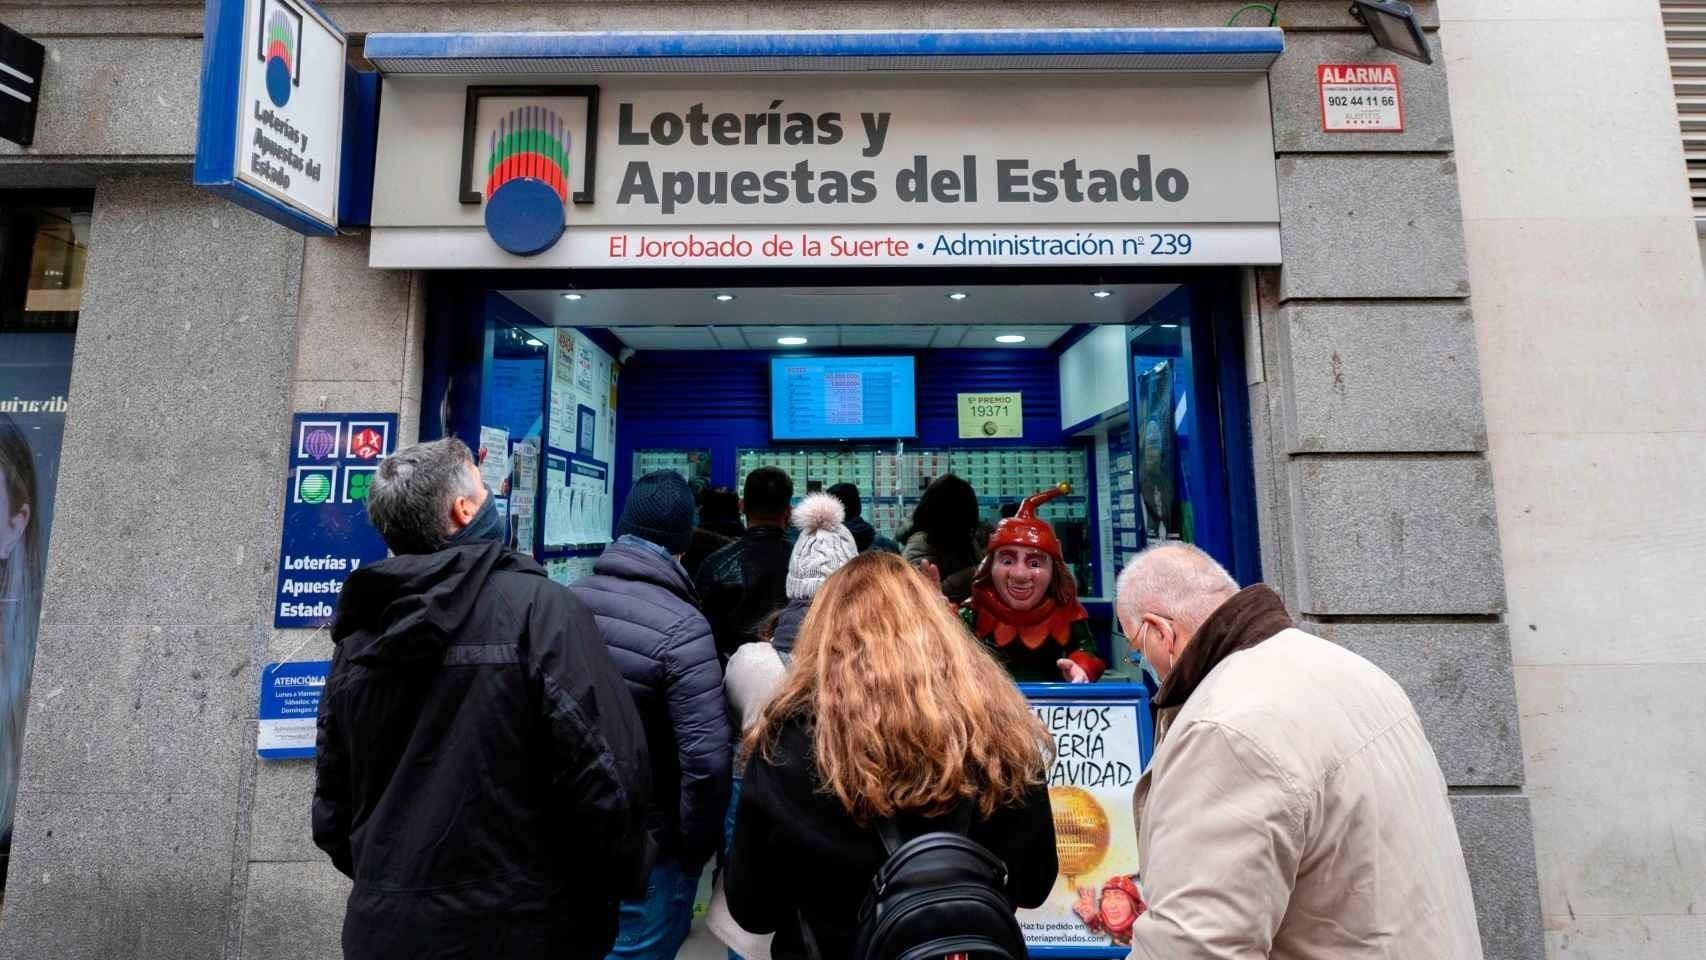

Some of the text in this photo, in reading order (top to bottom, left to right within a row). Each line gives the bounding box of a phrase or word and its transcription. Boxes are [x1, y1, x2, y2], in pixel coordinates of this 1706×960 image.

[1322, 67, 1396, 83] ALARMA
[1328, 96, 1394, 106] 902 44 11 66
[254, 100, 308, 153] Loterías y
[618, 100, 891, 157] Loterías y
[253, 127, 321, 182] Apuestas del
[251, 152, 290, 189] Estado
[616, 155, 1189, 214] Apuestas del Estado
[609, 235, 627, 257] El
[635, 234, 753, 257] Jorobado
[762, 234, 793, 257] de
[803, 234, 822, 257] la
[830, 235, 909, 257] Suerte
[932, 233, 1113, 256] Administración
[1150, 233, 1192, 255] 239
[978, 396, 1012, 404] PREMIO
[970, 405, 1008, 417] 19371
[284, 554, 360, 573] Loterías y
[280, 601, 333, 617] Estado
[1036, 922, 1045, 930] tu
[1046, 922, 1074, 932] pedido
